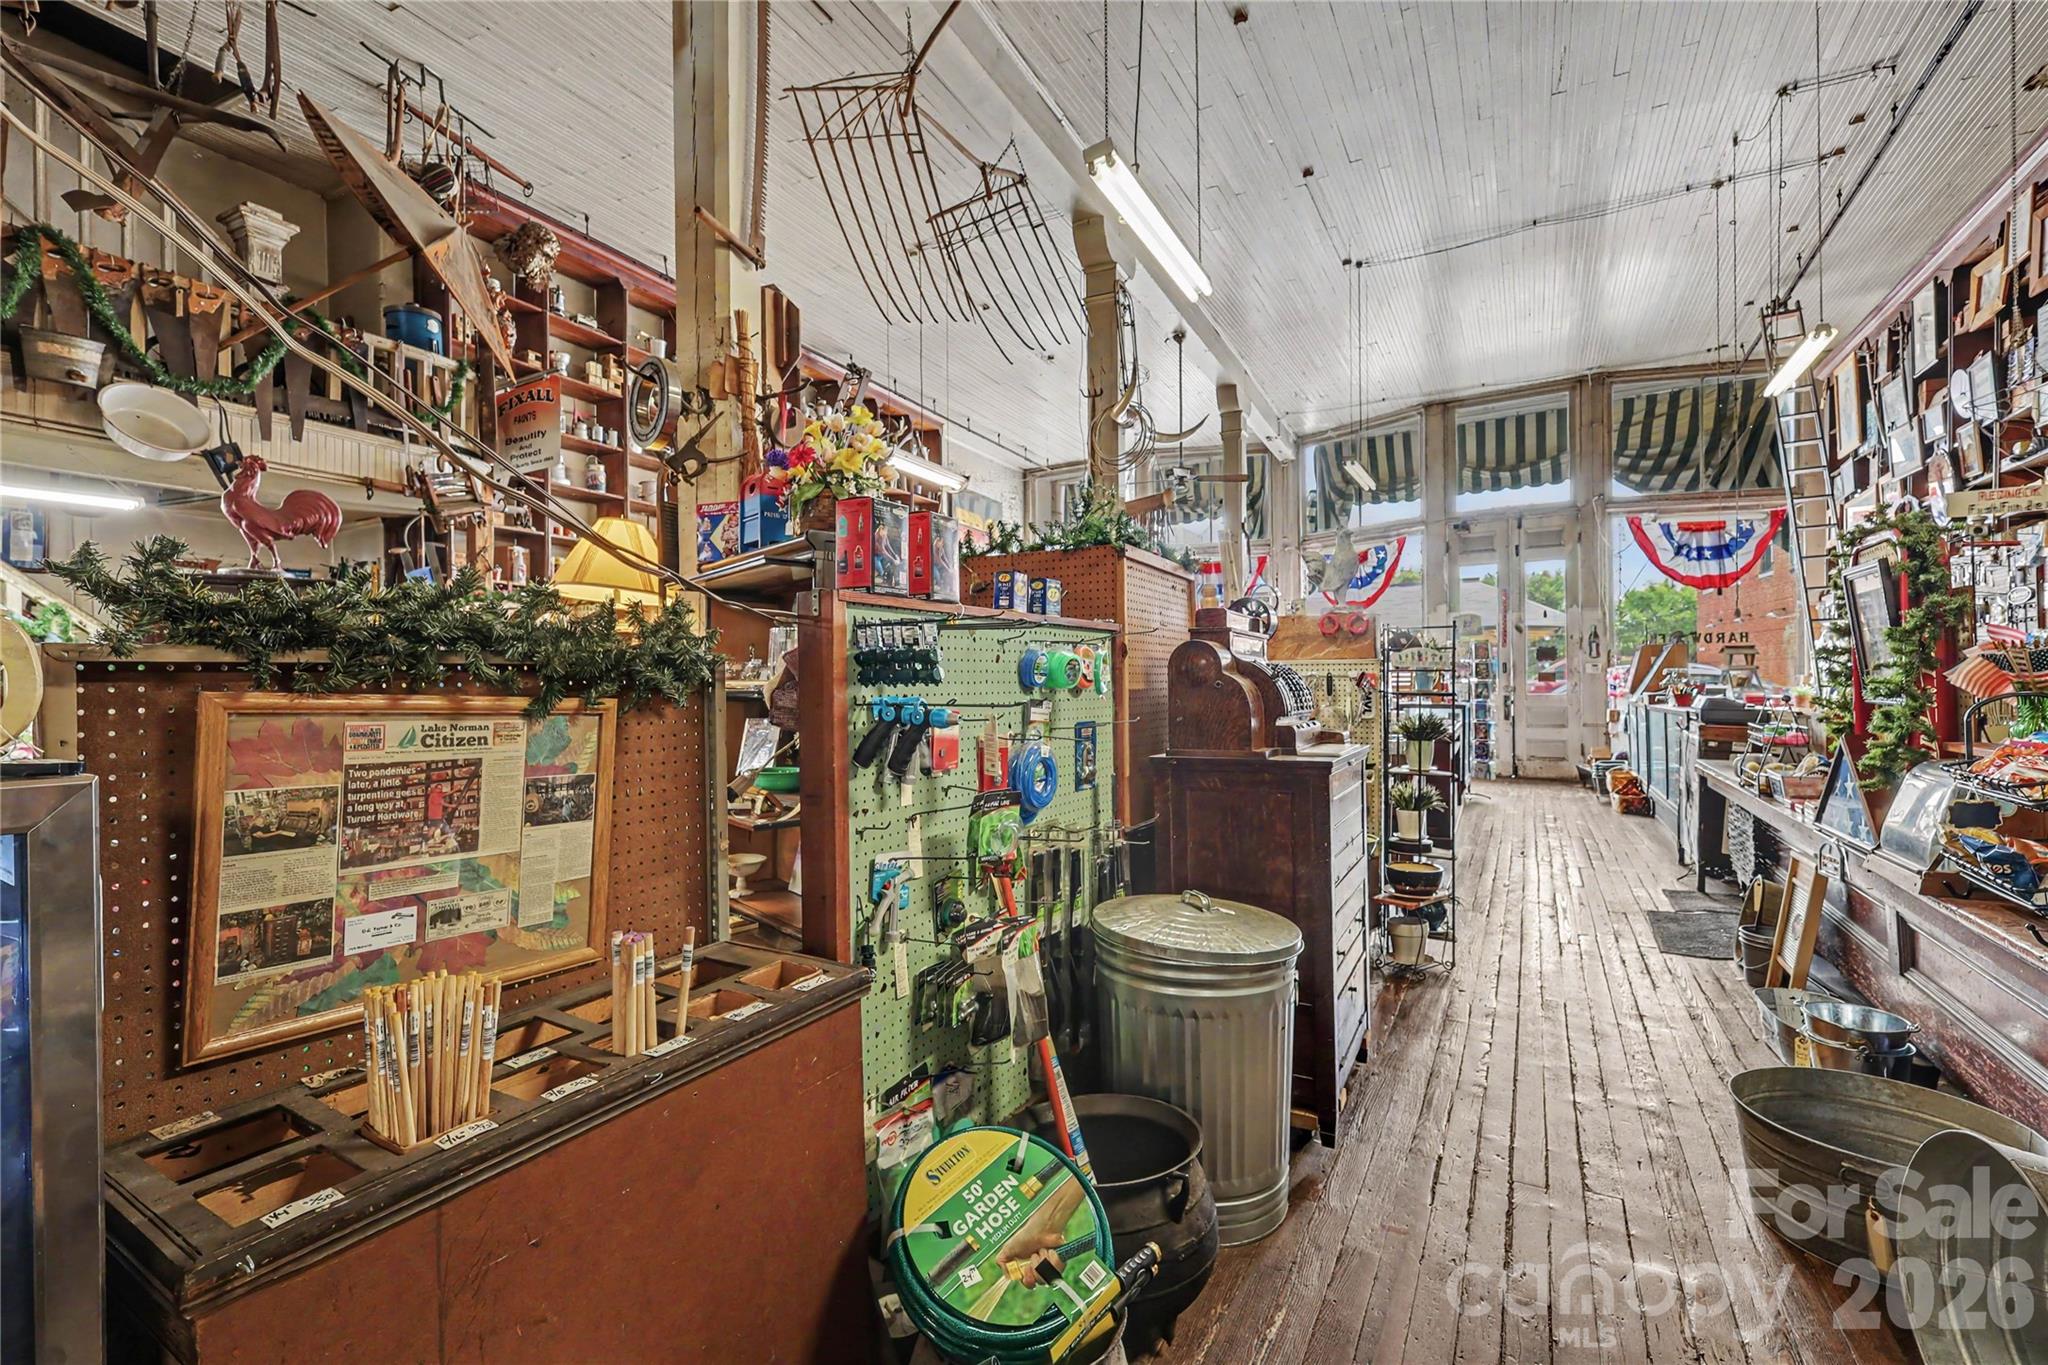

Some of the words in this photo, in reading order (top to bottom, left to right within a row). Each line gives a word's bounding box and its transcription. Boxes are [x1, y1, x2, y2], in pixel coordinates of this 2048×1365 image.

[498, 388, 554, 417] FIXALL
[513, 410, 537, 425] PAINTS
[505, 429, 547, 446] Beautify
[519, 443, 533, 451] And
[510, 448, 542, 462] Protect
[421, 723, 447, 733] Lake
[450, 723, 490, 732] Norman
[420, 732, 489, 748] Citizen
[348, 769, 368, 778] Two
[368, 766, 416, 778] pandemics
[348, 780, 372, 789] later,
[380, 778, 401, 788] little
[347, 789, 395, 802] turpentine
[395, 789, 417, 799] goes
[346, 805, 353, 813] a
[354, 803, 375, 813] long
[375, 801, 394, 811] way
[395, 800, 404, 808] at
[346, 814, 376, 824] Turner
[377, 811, 419, 821] Hardware
[952, 1174, 1019, 1236] GARDEN
[975, 1196, 1020, 1240] HOSE
